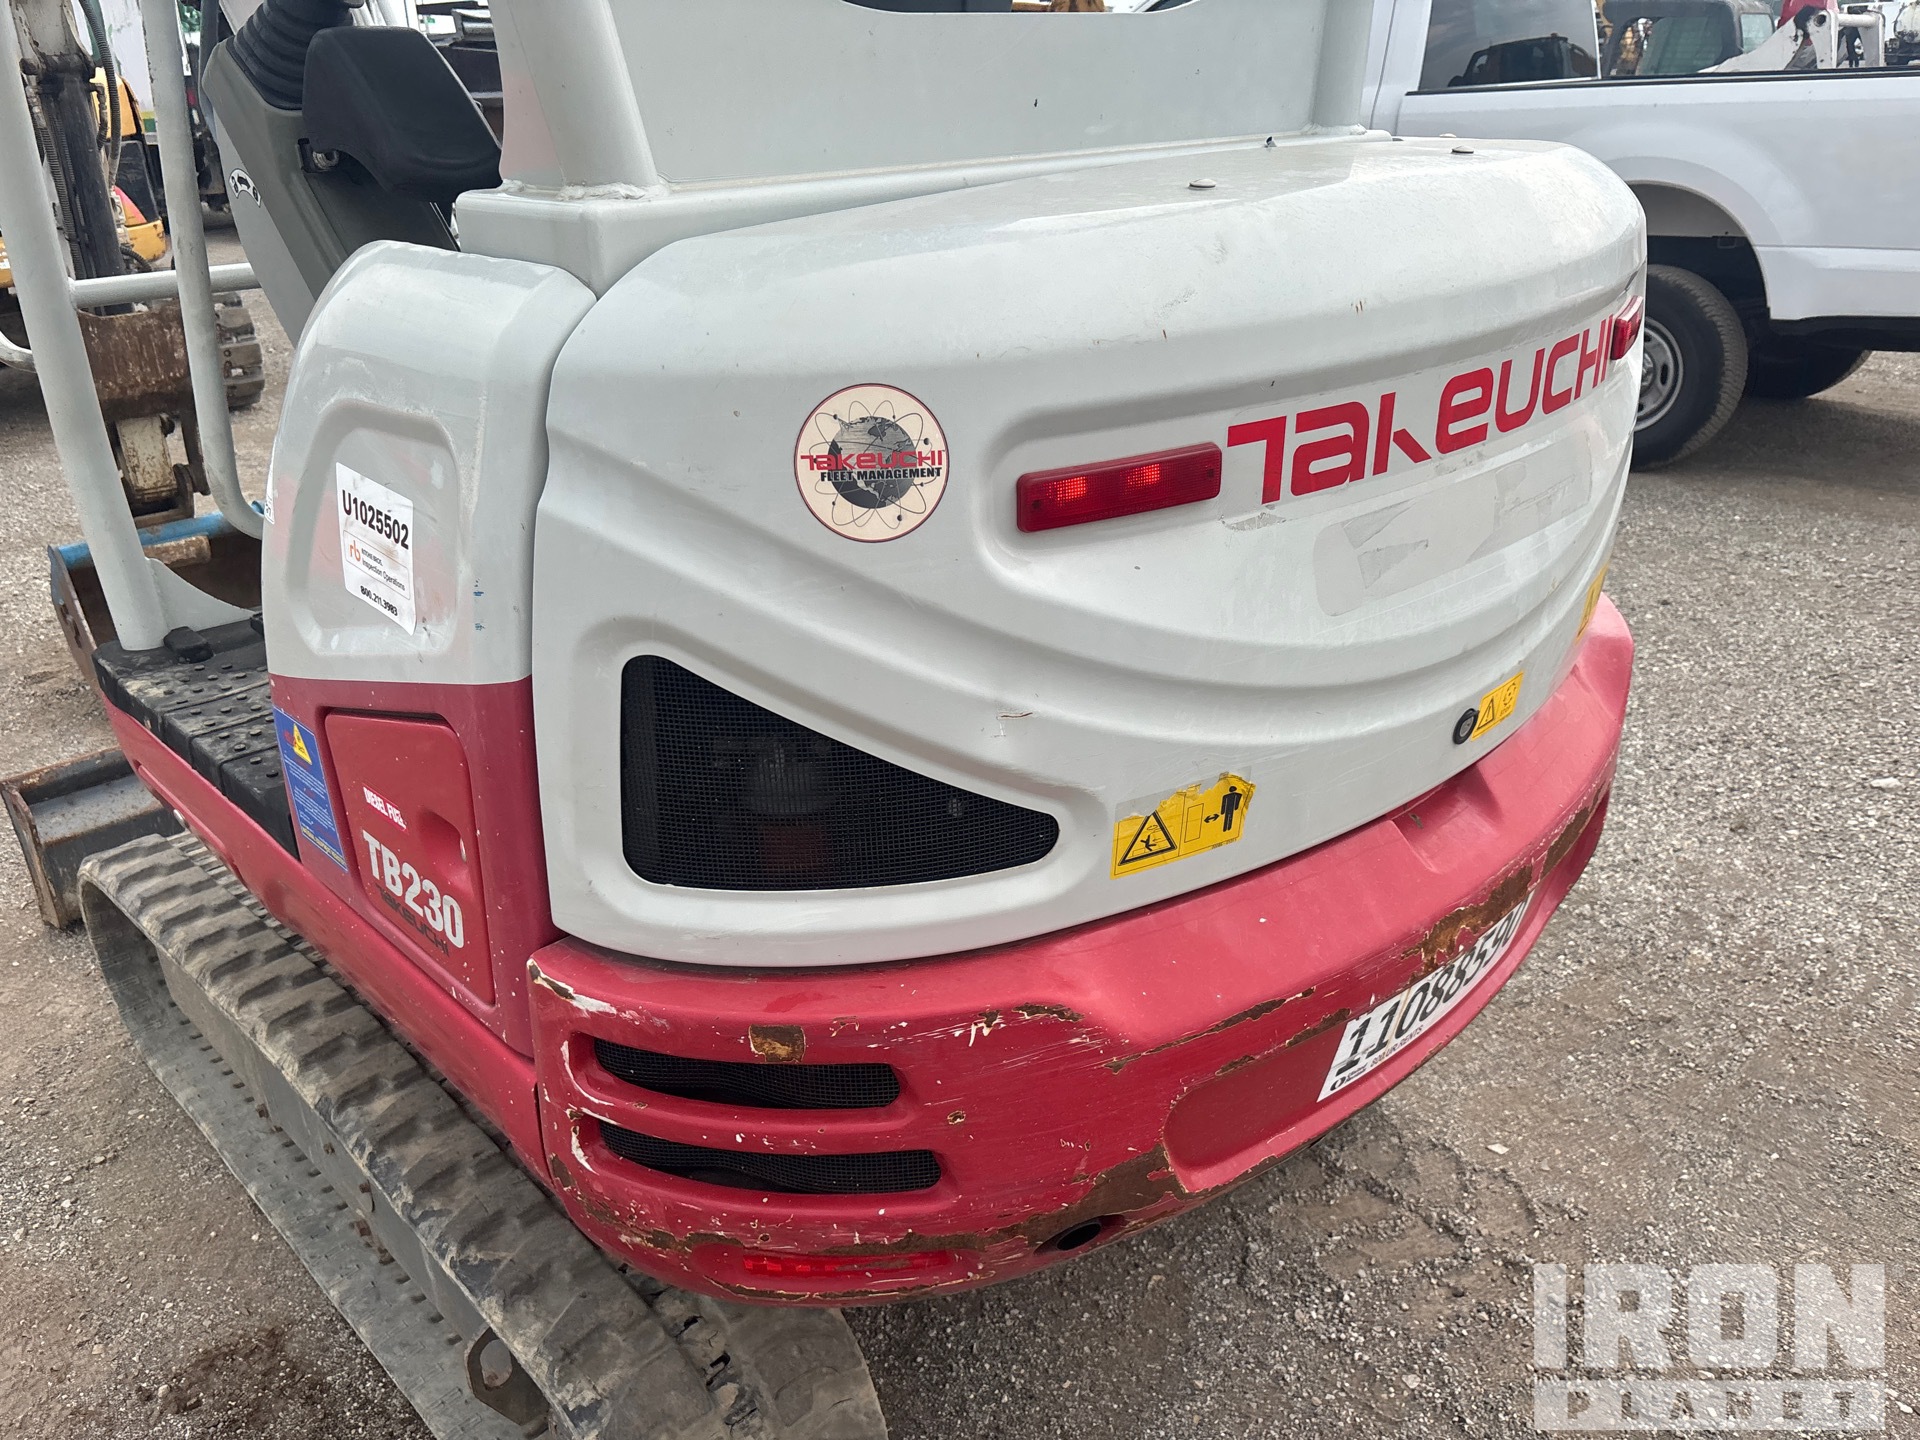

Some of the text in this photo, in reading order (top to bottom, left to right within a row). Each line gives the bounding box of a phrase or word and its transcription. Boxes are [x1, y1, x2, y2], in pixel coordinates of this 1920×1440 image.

[1227, 313, 1614, 505] TAKEUCHI
[800, 450, 943, 471] TAKEUCHI
[820, 467, 943, 482] FLEET MANAGEMENT
[341, 489, 410, 550] U1025502
[362, 558, 406, 591] Inspection Operations
[386, 802, 407, 830] FUEL
[362, 829, 465, 949] TB230
